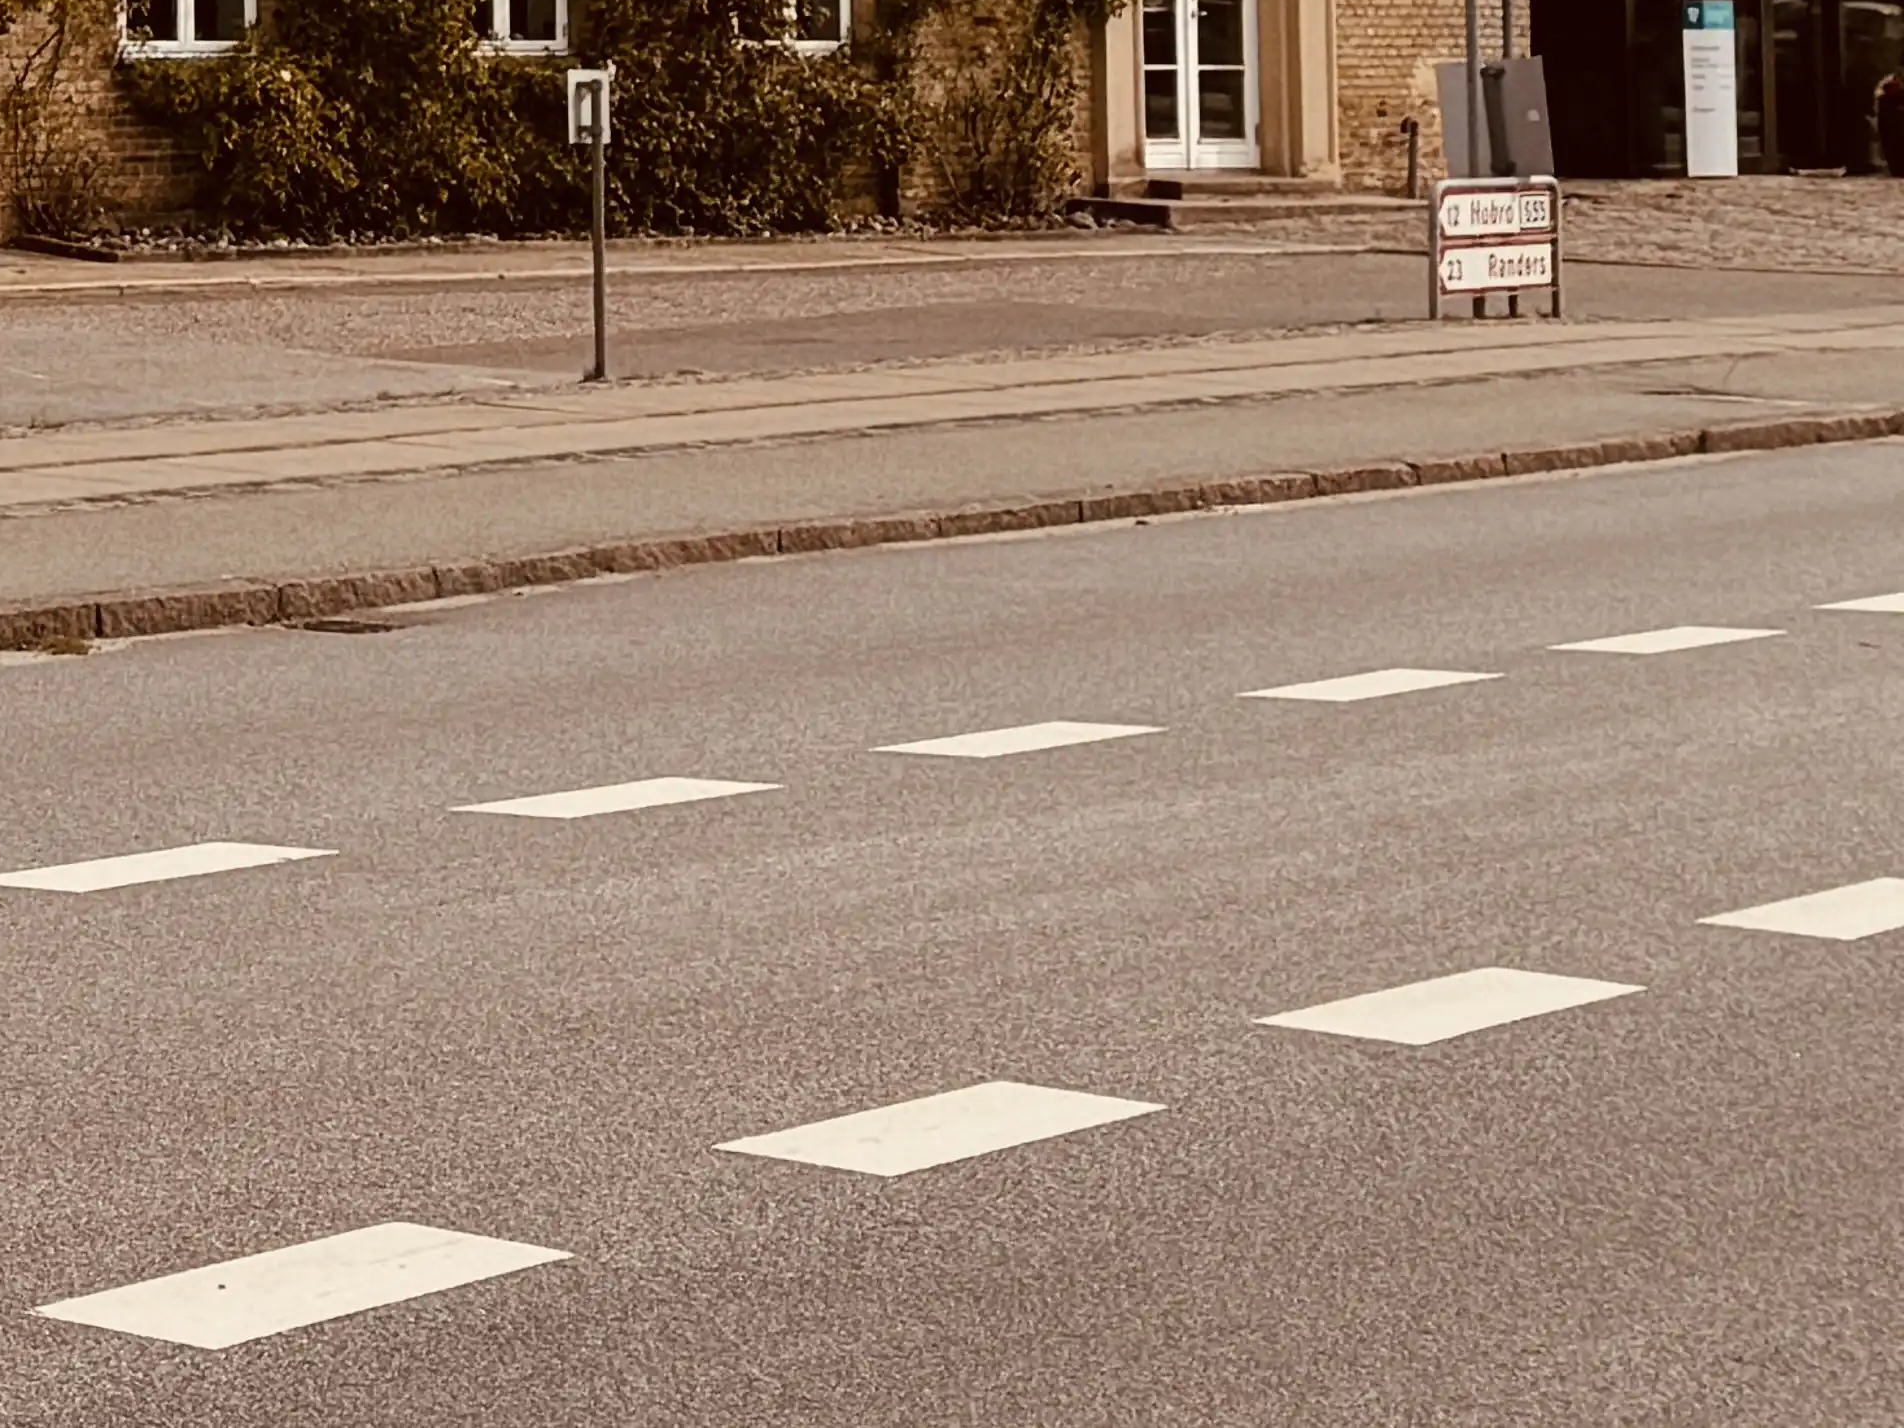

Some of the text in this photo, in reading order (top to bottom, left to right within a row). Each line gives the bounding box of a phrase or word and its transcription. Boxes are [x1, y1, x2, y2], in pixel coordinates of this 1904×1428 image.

[1470, 199, 1513, 226] Hobro
[1447, 253, 1546, 281] 23 Randers
